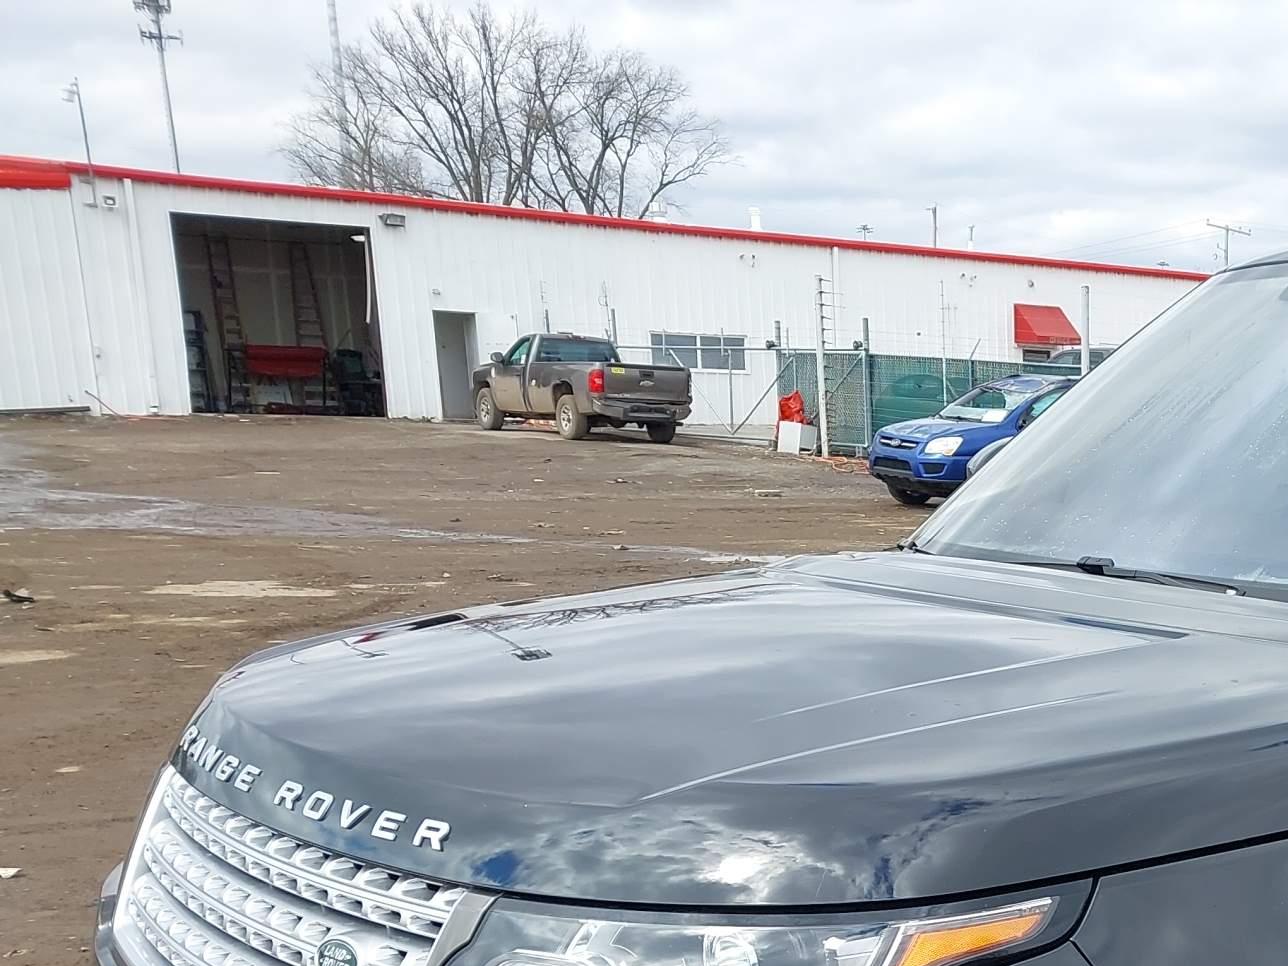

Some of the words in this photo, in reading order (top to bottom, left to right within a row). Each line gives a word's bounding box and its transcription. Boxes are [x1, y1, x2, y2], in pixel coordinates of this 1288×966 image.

[182, 724, 264, 793] RANGE
[273, 779, 452, 852] ROVER
[323, 944, 347, 961] LAND
